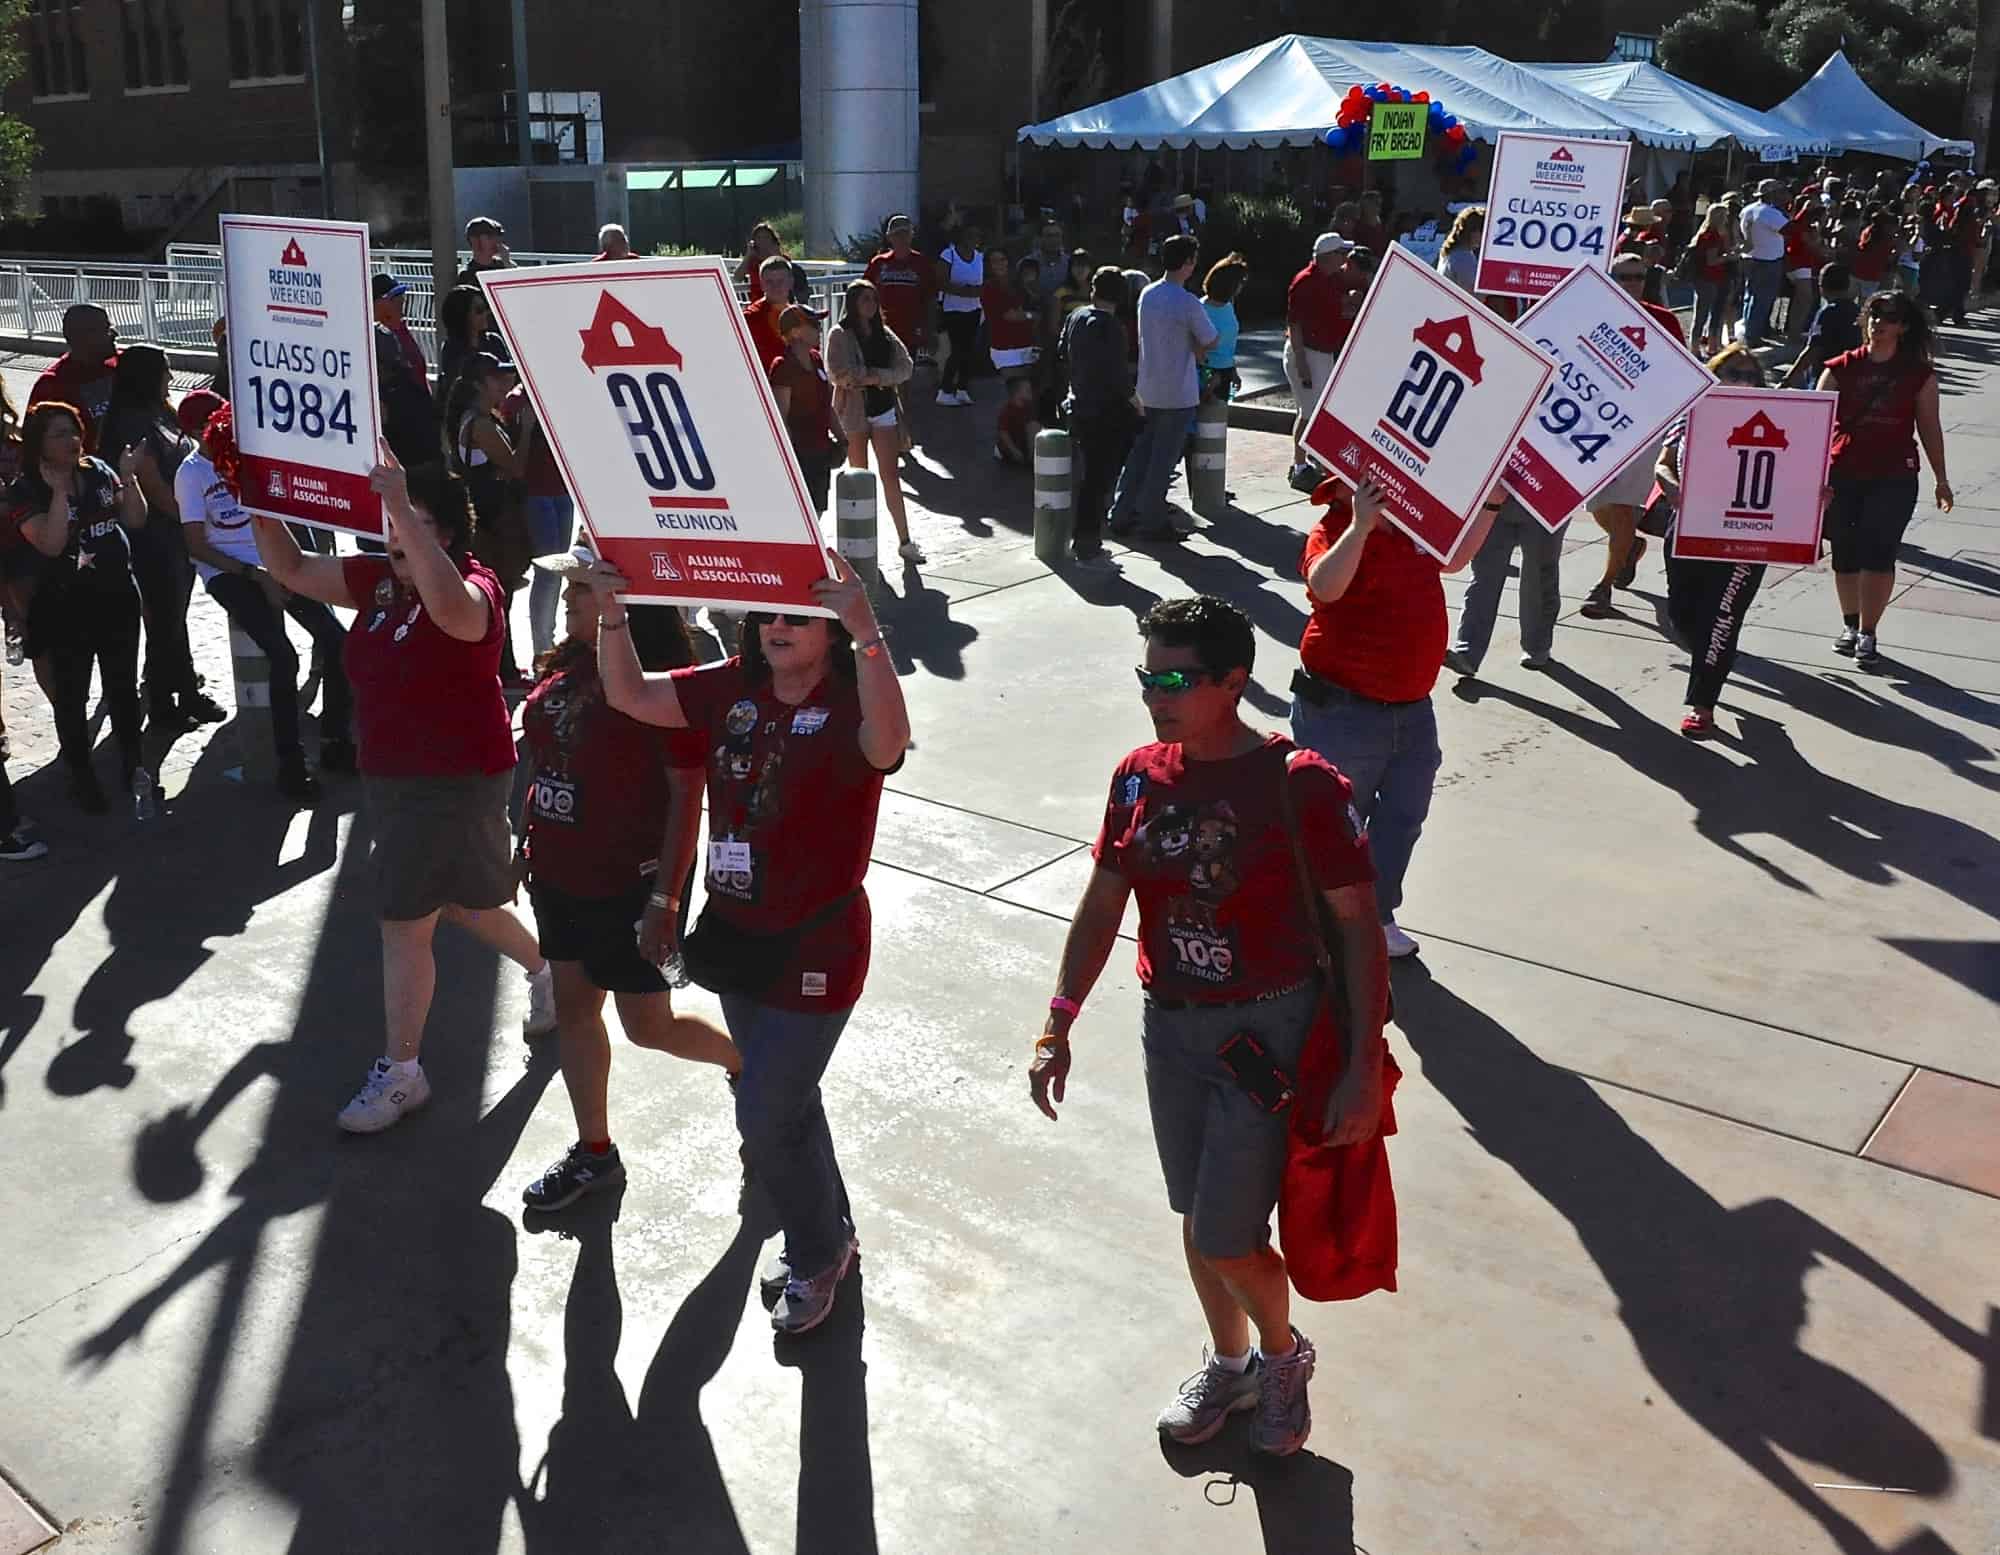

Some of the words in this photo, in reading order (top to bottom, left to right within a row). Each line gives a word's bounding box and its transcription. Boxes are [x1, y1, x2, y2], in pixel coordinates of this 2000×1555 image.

[1383, 111, 1415, 129] INDIAN
[1371, 133, 1389, 151] FRY
[1391, 132, 1421, 150] BREAD
[1535, 171, 1583, 182] WEEKEND
[1536, 161, 1584, 173] REUNION
[1508, 198, 1567, 217] CLASS
[1574, 204, 1600, 221] OF
[1492, 217, 1604, 255] 2004
[269, 269, 322, 289] REUNION
[270, 286, 322, 306] WEEKEND
[249, 339, 315, 374] CLASS
[323, 349, 351, 379] OF
[1589, 330, 1640, 380] WEEKEND
[1597, 322, 1650, 373] REUNION
[248, 376, 358, 445] 1984
[1385, 350, 1465, 449] 20
[1598, 401, 1634, 431] OF
[606, 372, 716, 491] 30
[1371, 428, 1425, 478] REUNION
[292, 475, 328, 492] ALUMNI
[1369, 461, 1408, 495] ALUMNI
[1508, 459, 1543, 492] CIATION
[1731, 449, 1776, 510] 10
[293, 491, 351, 510] ASSOCIATION
[655, 513, 738, 531] REUNION
[1723, 520, 1774, 532] REUNION
[687, 555, 743, 569] ALUMNI
[693, 570, 783, 586] ASSOCIATION
